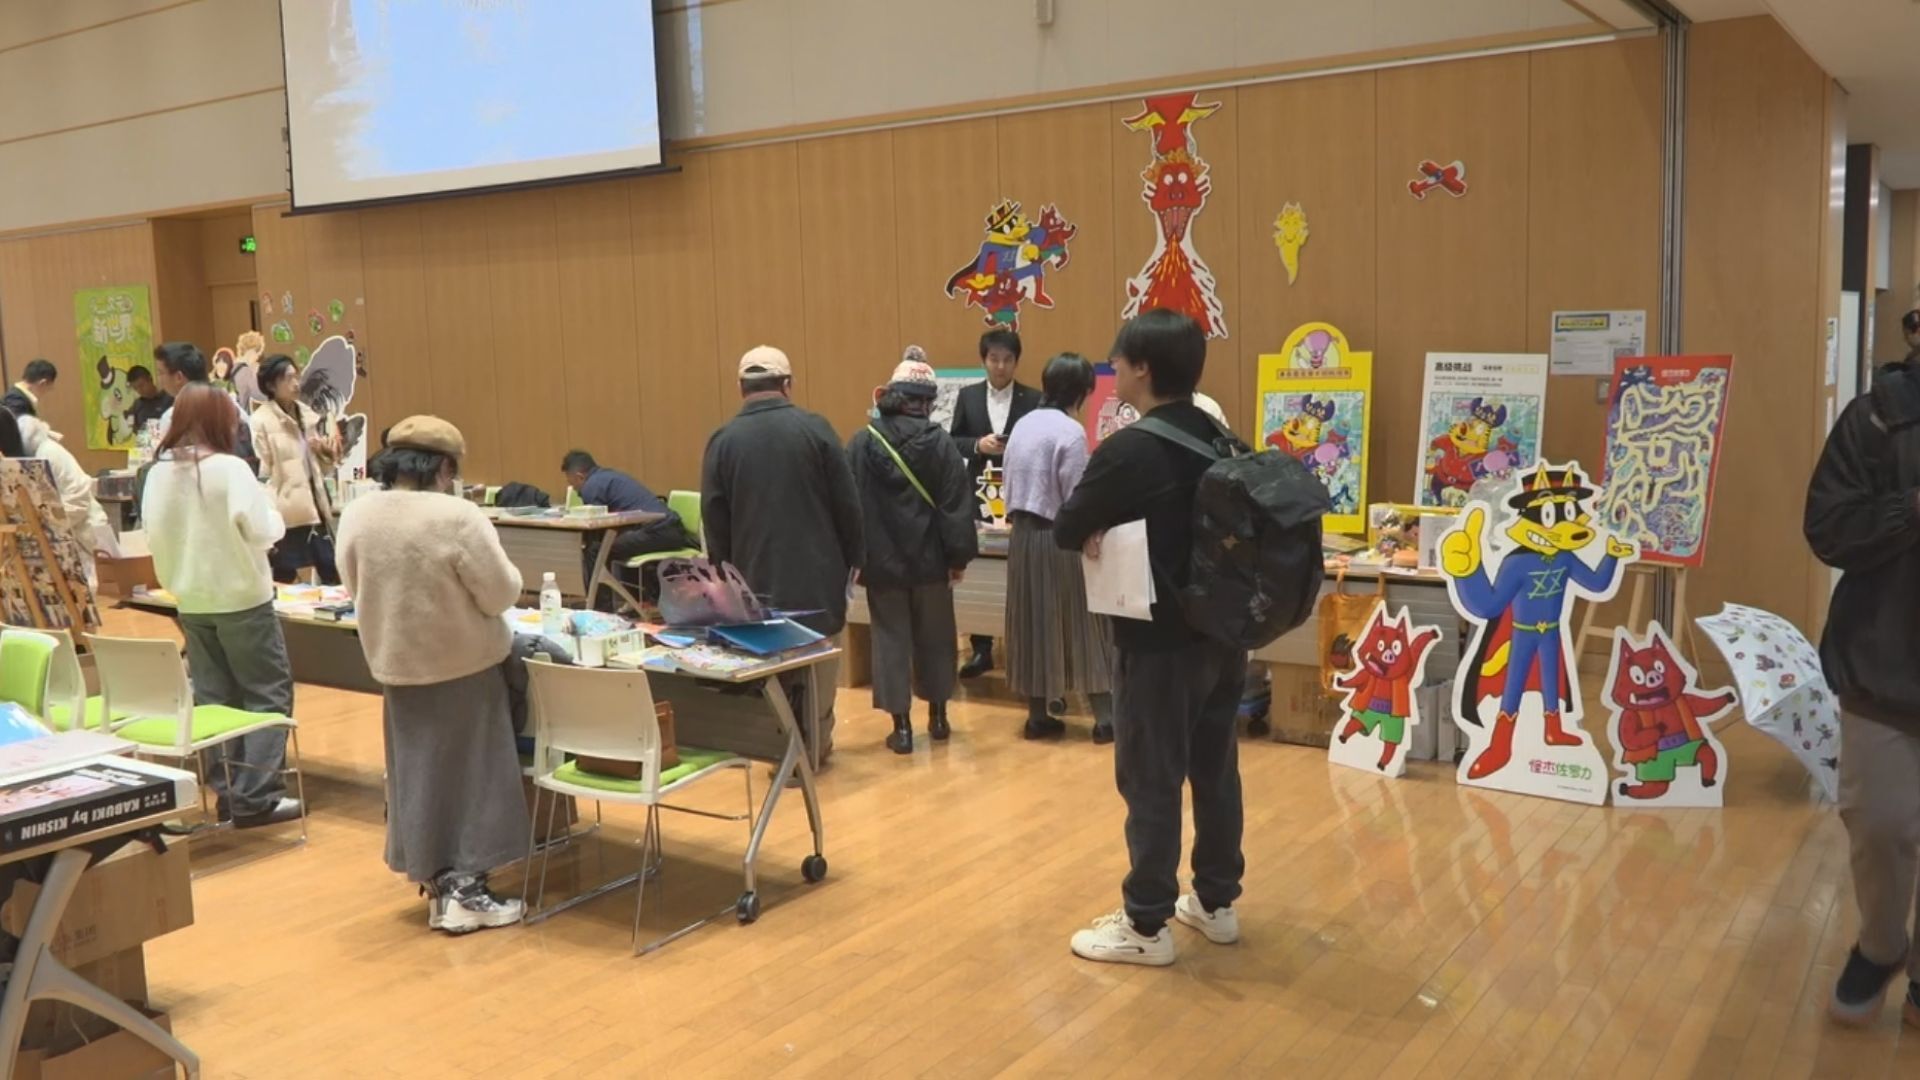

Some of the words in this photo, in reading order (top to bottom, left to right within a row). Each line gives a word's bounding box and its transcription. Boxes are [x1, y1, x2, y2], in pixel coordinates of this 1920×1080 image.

[1529, 759, 1592, 781] 怪杰佐罗力
[71, 809, 89, 824] by
[91, 798, 140, 822] KABUKI
[20, 816, 69, 840] KISHIN
